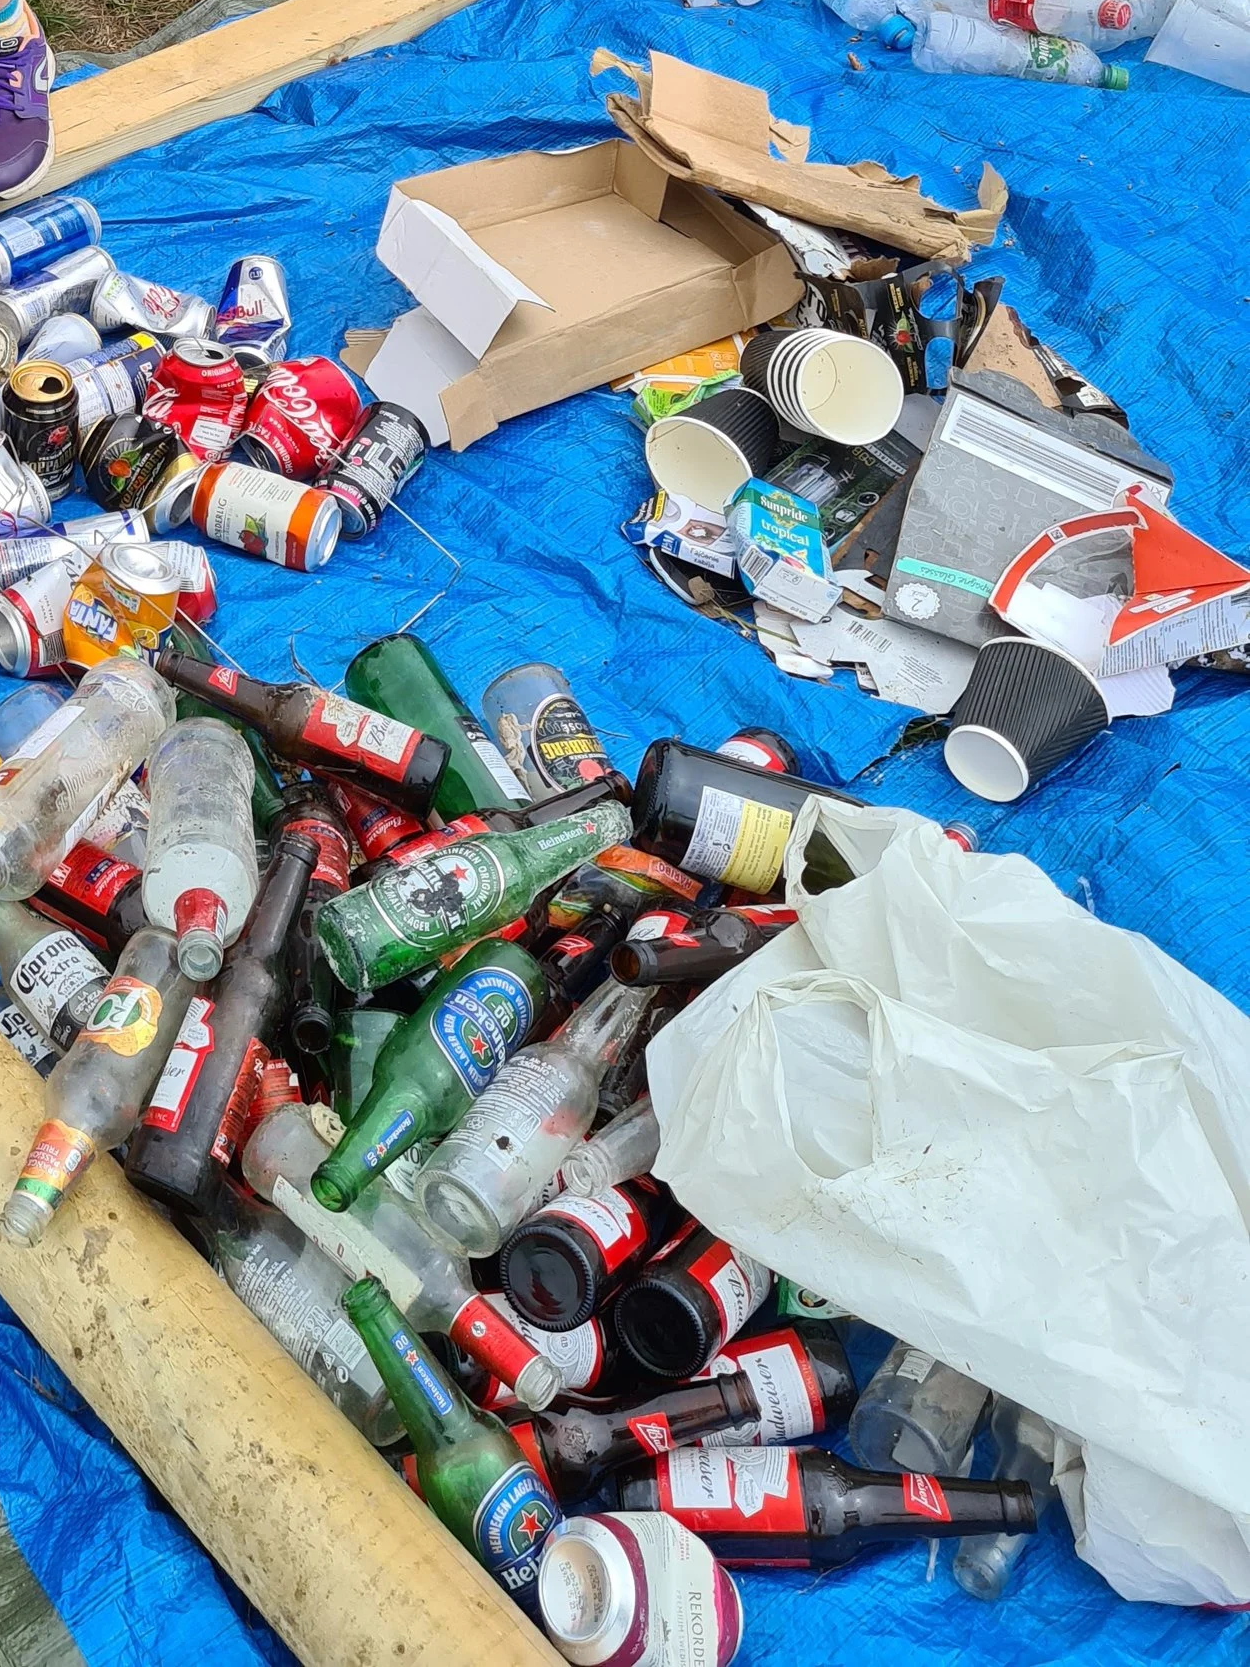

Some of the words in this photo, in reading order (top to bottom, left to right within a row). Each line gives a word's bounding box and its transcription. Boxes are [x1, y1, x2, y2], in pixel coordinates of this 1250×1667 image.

[237, 299, 264, 318] Bull
[269, 433, 294, 475] ORIGINAL
[759, 494, 809, 523] Sunpride
[760, 518, 811, 548] tropical
[919, 566, 957, 580] Glasses
[910, 597, 923, 612] 2
[69, 600, 119, 644] FANTA
[537, 824, 583, 852] Heineken
[470, 864, 492, 911] ORIGINAL
[657, 859, 694, 890] HARIBO
[402, 911, 431, 933] LAGER
[15, 935, 81, 996] Corona
[39, 955, 81, 988] Extra
[476, 976, 516, 996] QUALITY
[443, 1013, 457, 1034] BEER
[448, 1034, 471, 1066] LAGER
[414, 1364, 448, 1409] Heineken
[754, 1357, 787, 1446] Budweiser
[488, 1498, 513, 1555] HEINEKEN
[507, 1477, 535, 1503] LAGER
[688, 1590, 706, 1667] REKORDE
